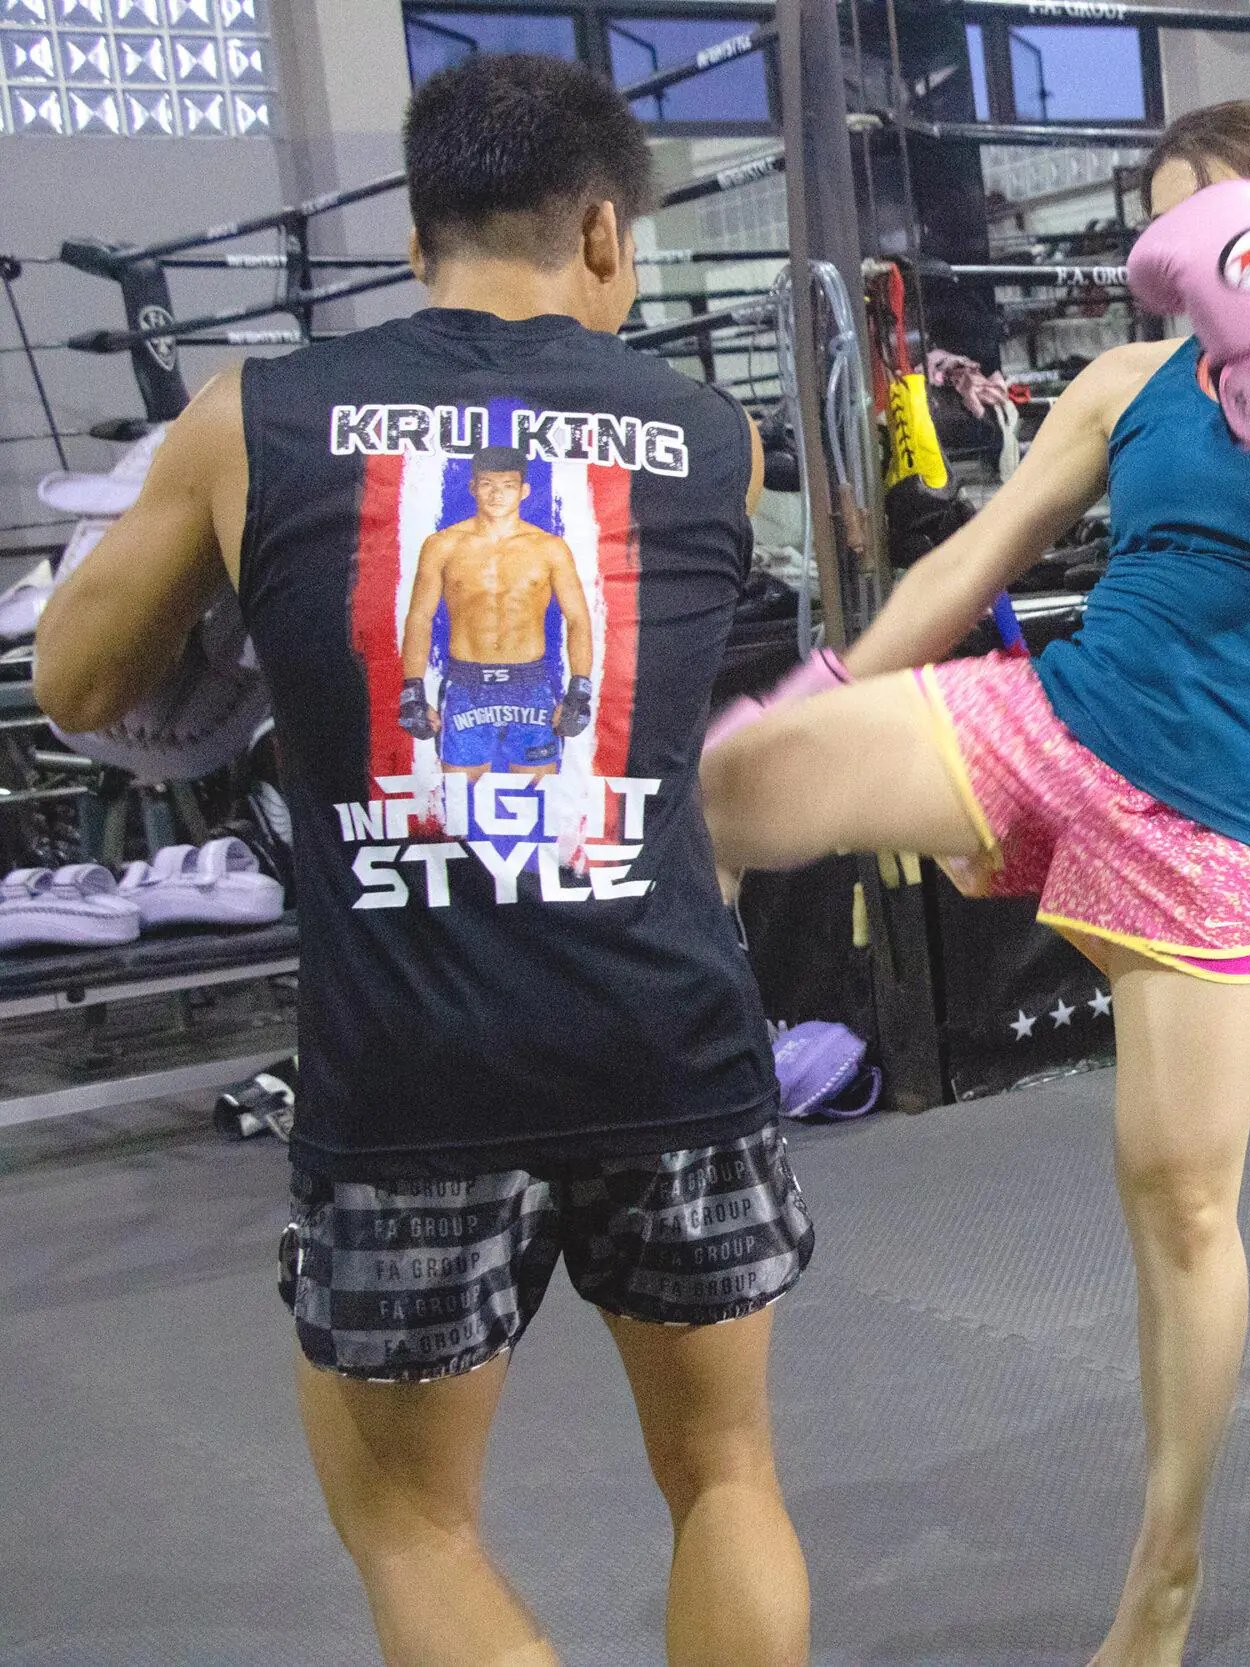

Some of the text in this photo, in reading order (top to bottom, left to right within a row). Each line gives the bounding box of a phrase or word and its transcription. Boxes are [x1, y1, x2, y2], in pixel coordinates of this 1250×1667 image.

[1092, 266, 1128, 285] GRO
[331, 404, 689, 478] KRU KING
[482, 669, 510, 682] FS
[452, 705, 548, 732] INFIGHTSTYLE
[351, 840, 657, 909] STYLE
[410, 1215, 478, 1238] GROUP
[690, 1197, 752, 1229] GROUP
[412, 1252, 480, 1279] GROUP
